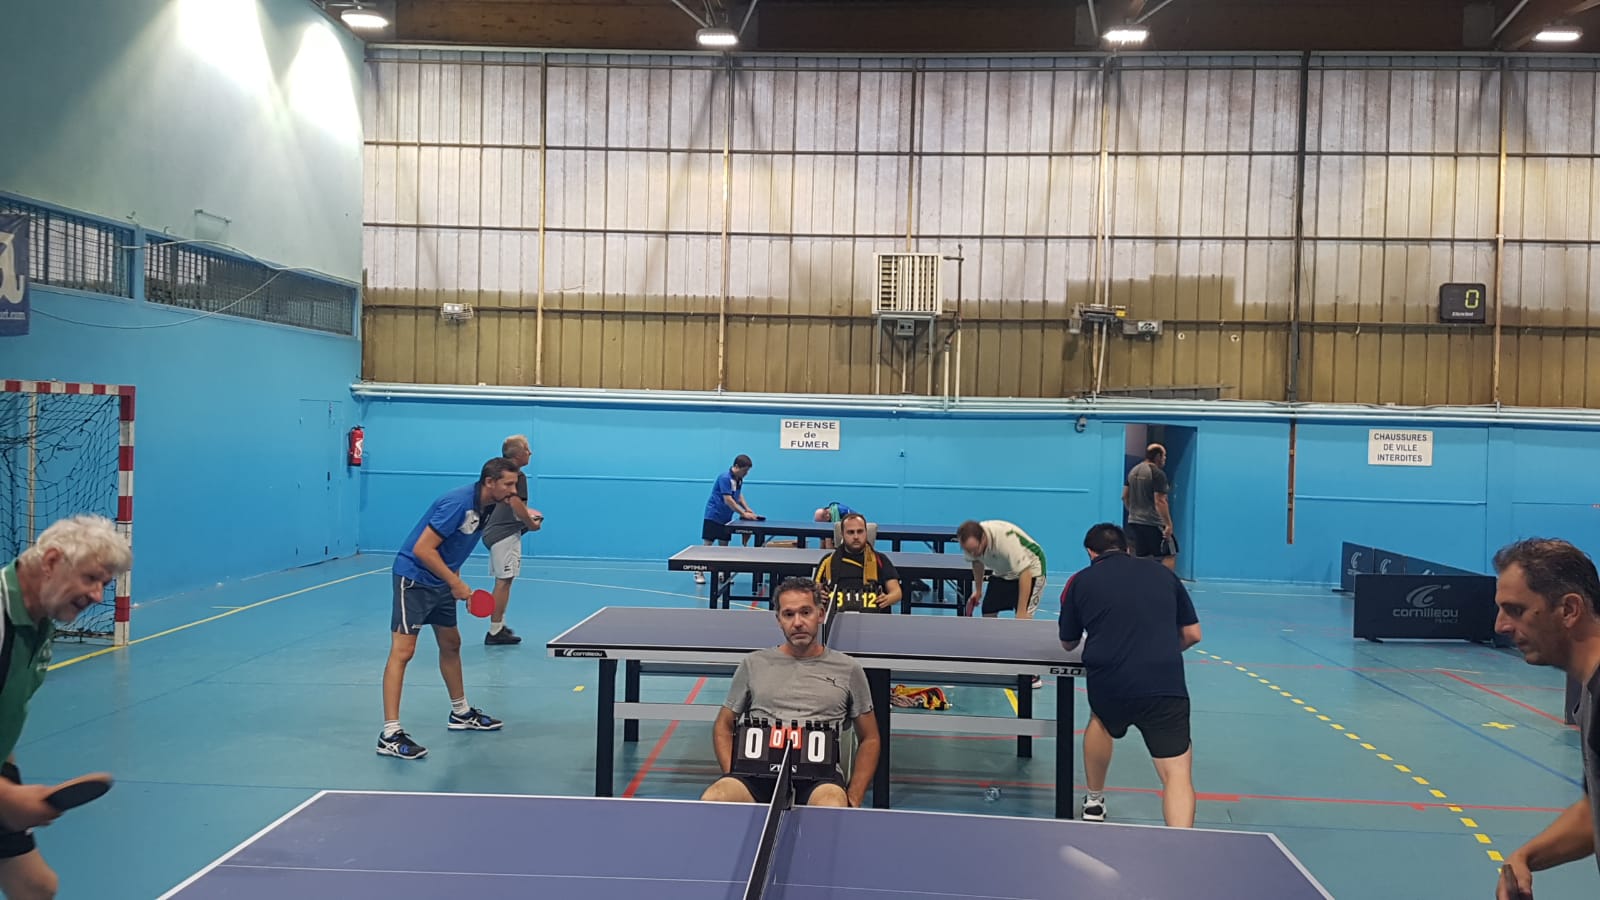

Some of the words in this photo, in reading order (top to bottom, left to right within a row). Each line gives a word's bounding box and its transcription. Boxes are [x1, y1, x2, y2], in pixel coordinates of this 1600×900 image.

[1465, 289, 1479, 309] 0
[784, 421, 836, 429] DEFENSE
[1373, 433, 1427, 441] CHAUSSURES
[790, 440, 829, 448] FUMER
[1383, 443, 1394, 451] DE
[1396, 443, 1418, 452] VILLE
[1377, 453, 1423, 462] INTERDITES
[861, 592, 877, 608] 12
[1392, 607, 1459, 618] cornilleau
[744, 727, 764, 759] 0
[772, 729, 782, 747] 0
[807, 730, 826, 763] 0
